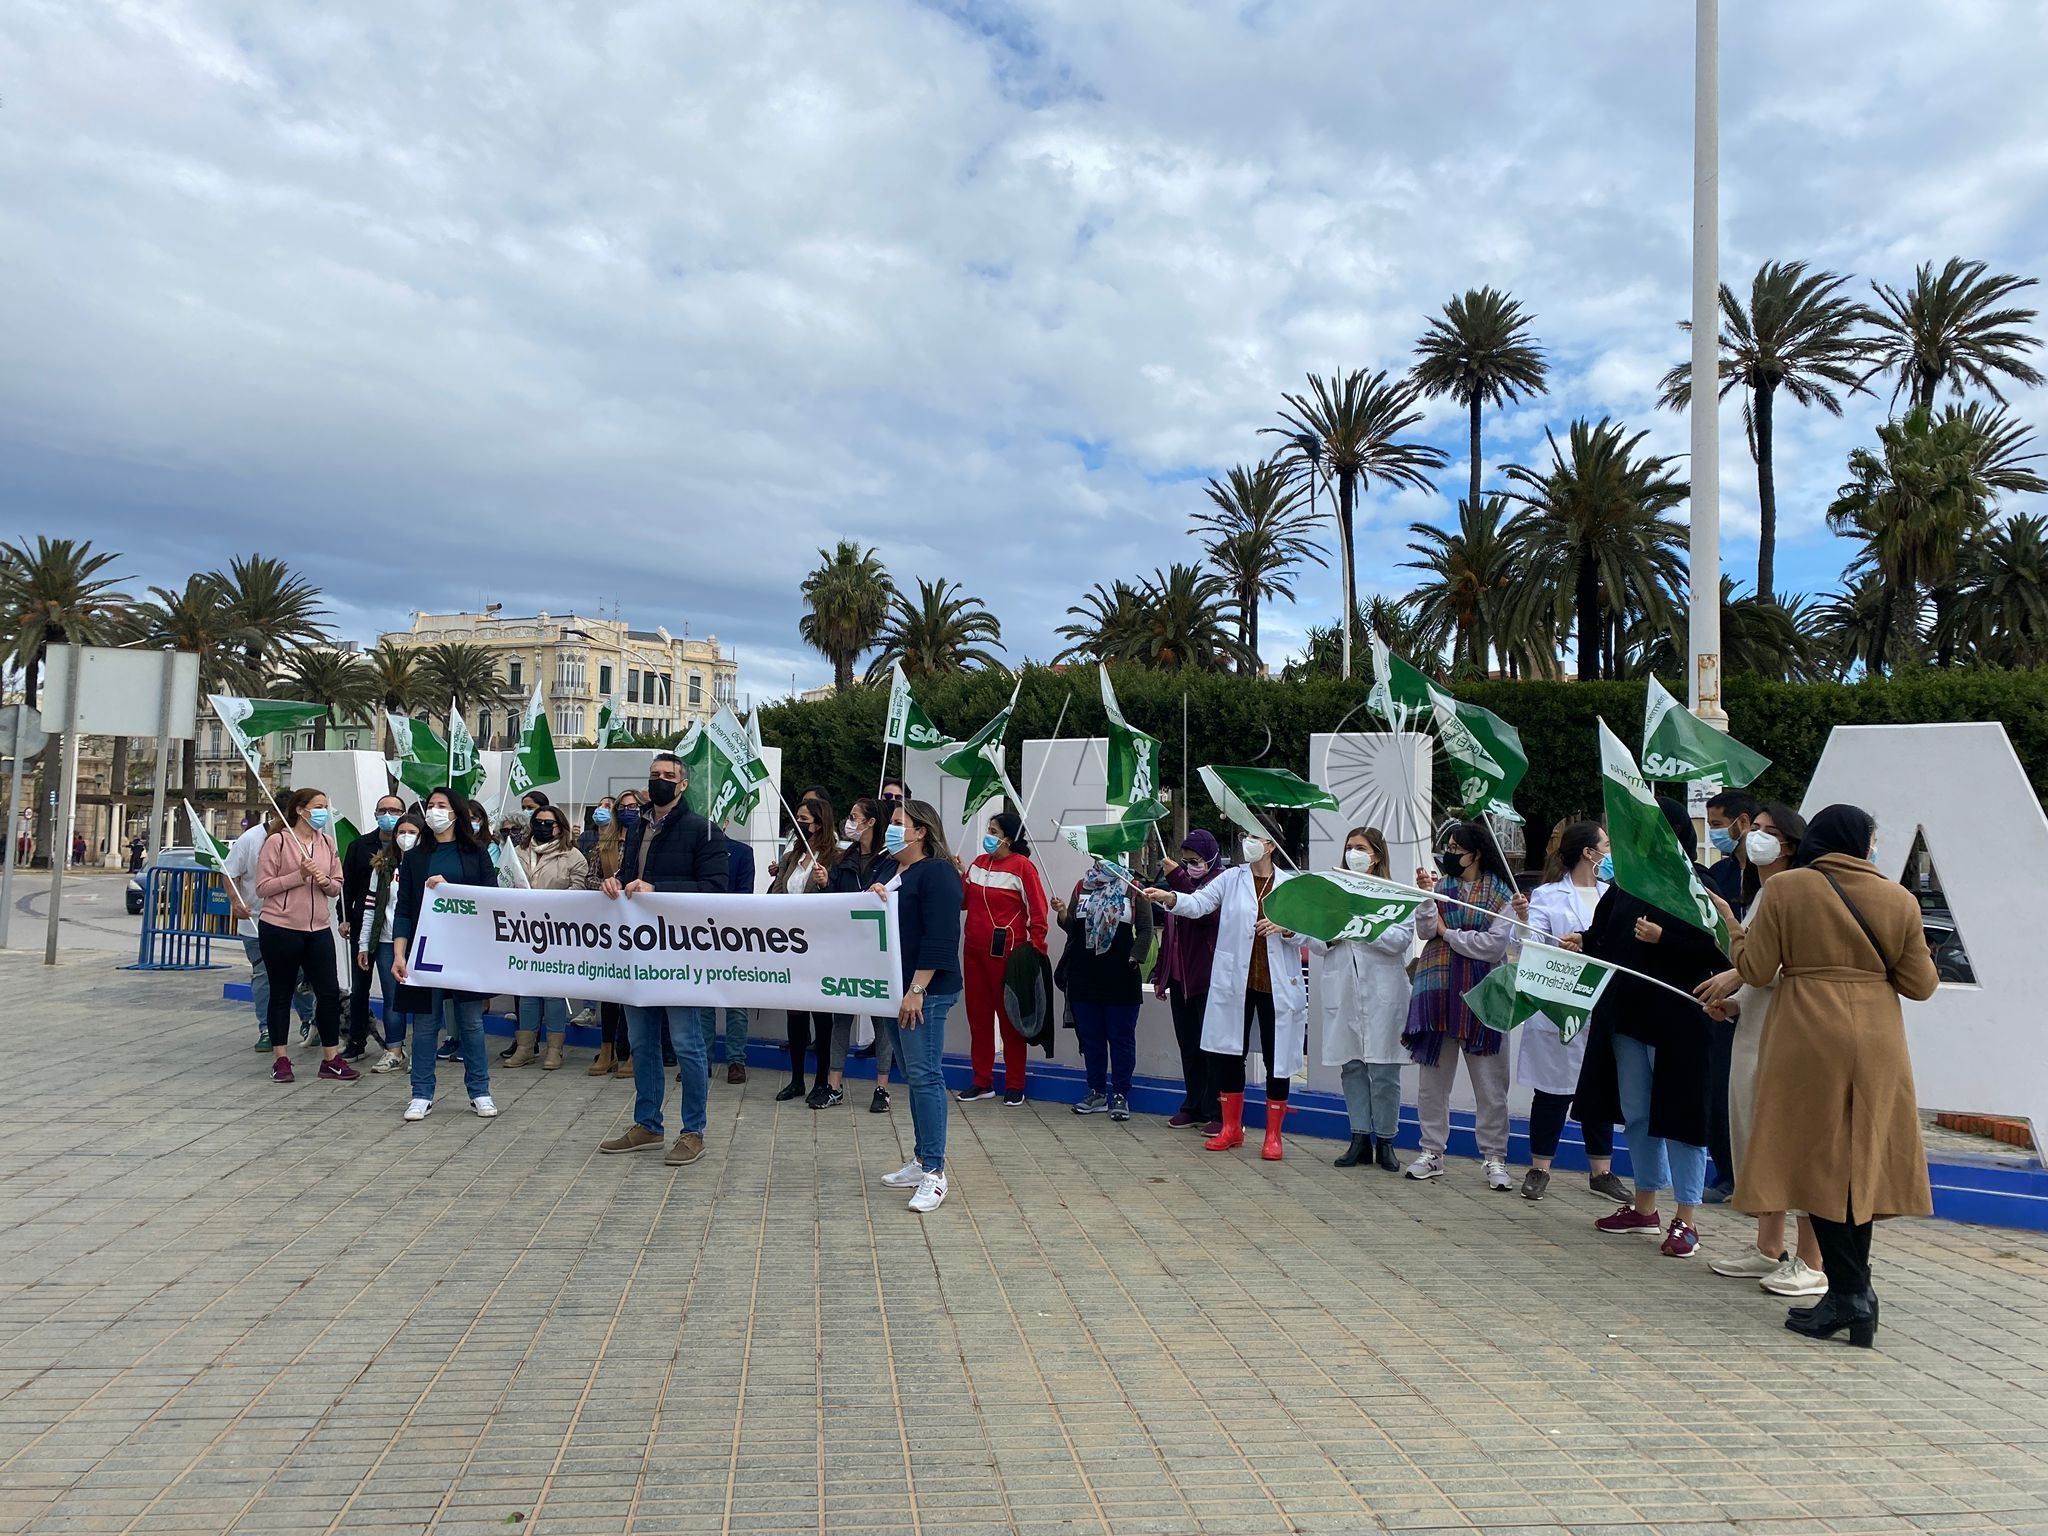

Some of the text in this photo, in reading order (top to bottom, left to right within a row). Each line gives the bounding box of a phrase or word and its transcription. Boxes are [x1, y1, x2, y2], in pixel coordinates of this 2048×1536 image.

[432, 897, 478, 915] SATSE
[493, 910, 809, 954] Exigimos soluciones
[508, 955, 791, 985] Por nuestra dignidad laboral y profesional
[821, 976, 890, 999] SATSE
